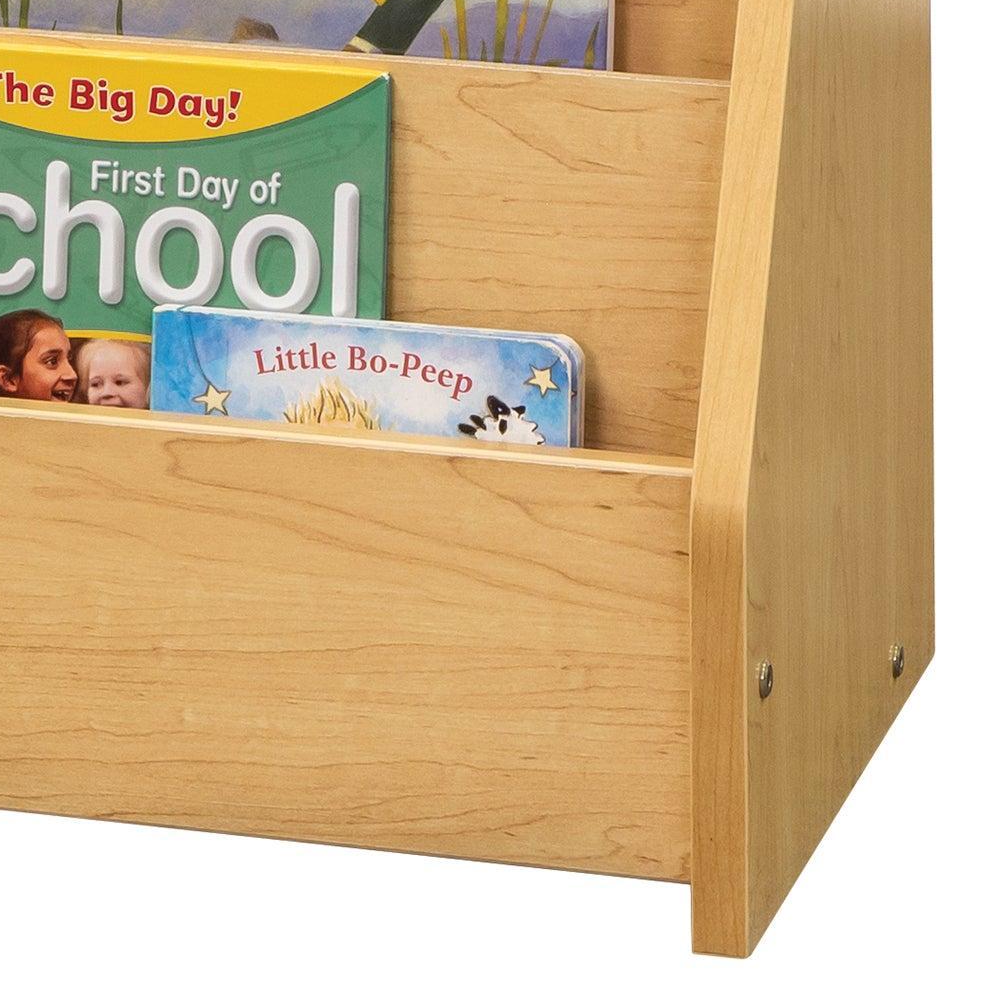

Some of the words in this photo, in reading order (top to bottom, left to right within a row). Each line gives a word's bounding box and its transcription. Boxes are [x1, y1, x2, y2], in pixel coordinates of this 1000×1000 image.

[68, 78, 136, 123] Big
[148, 87, 242, 128] Day!
[90, 159, 166, 198] First
[176, 165, 239, 211] Day
[248, 171, 282, 206] of
[253, 342, 338, 376] Little
[346, 344, 474, 401] Bo-Peep
